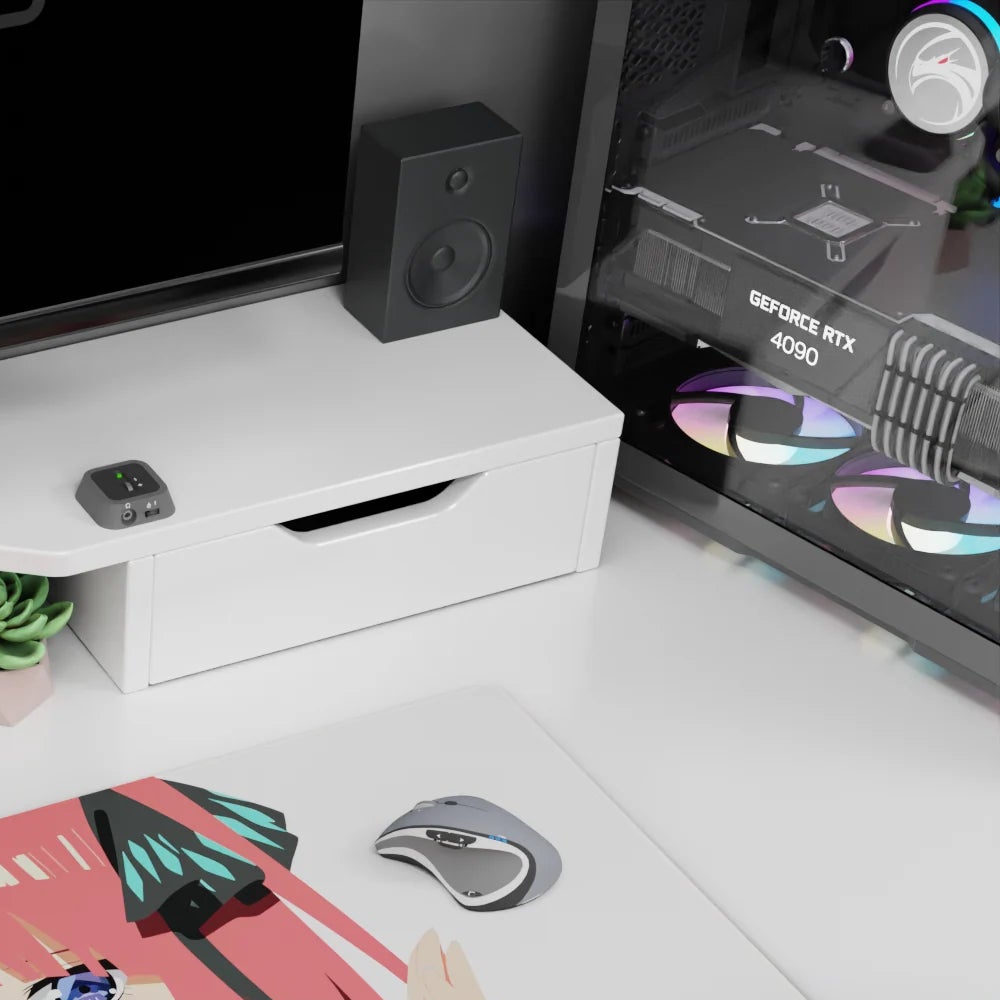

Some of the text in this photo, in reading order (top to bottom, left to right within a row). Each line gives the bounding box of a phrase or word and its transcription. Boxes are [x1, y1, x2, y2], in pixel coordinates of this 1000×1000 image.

[749, 289, 856, 354] GEFORCE RTX
[770, 332, 819, 366] 4090
